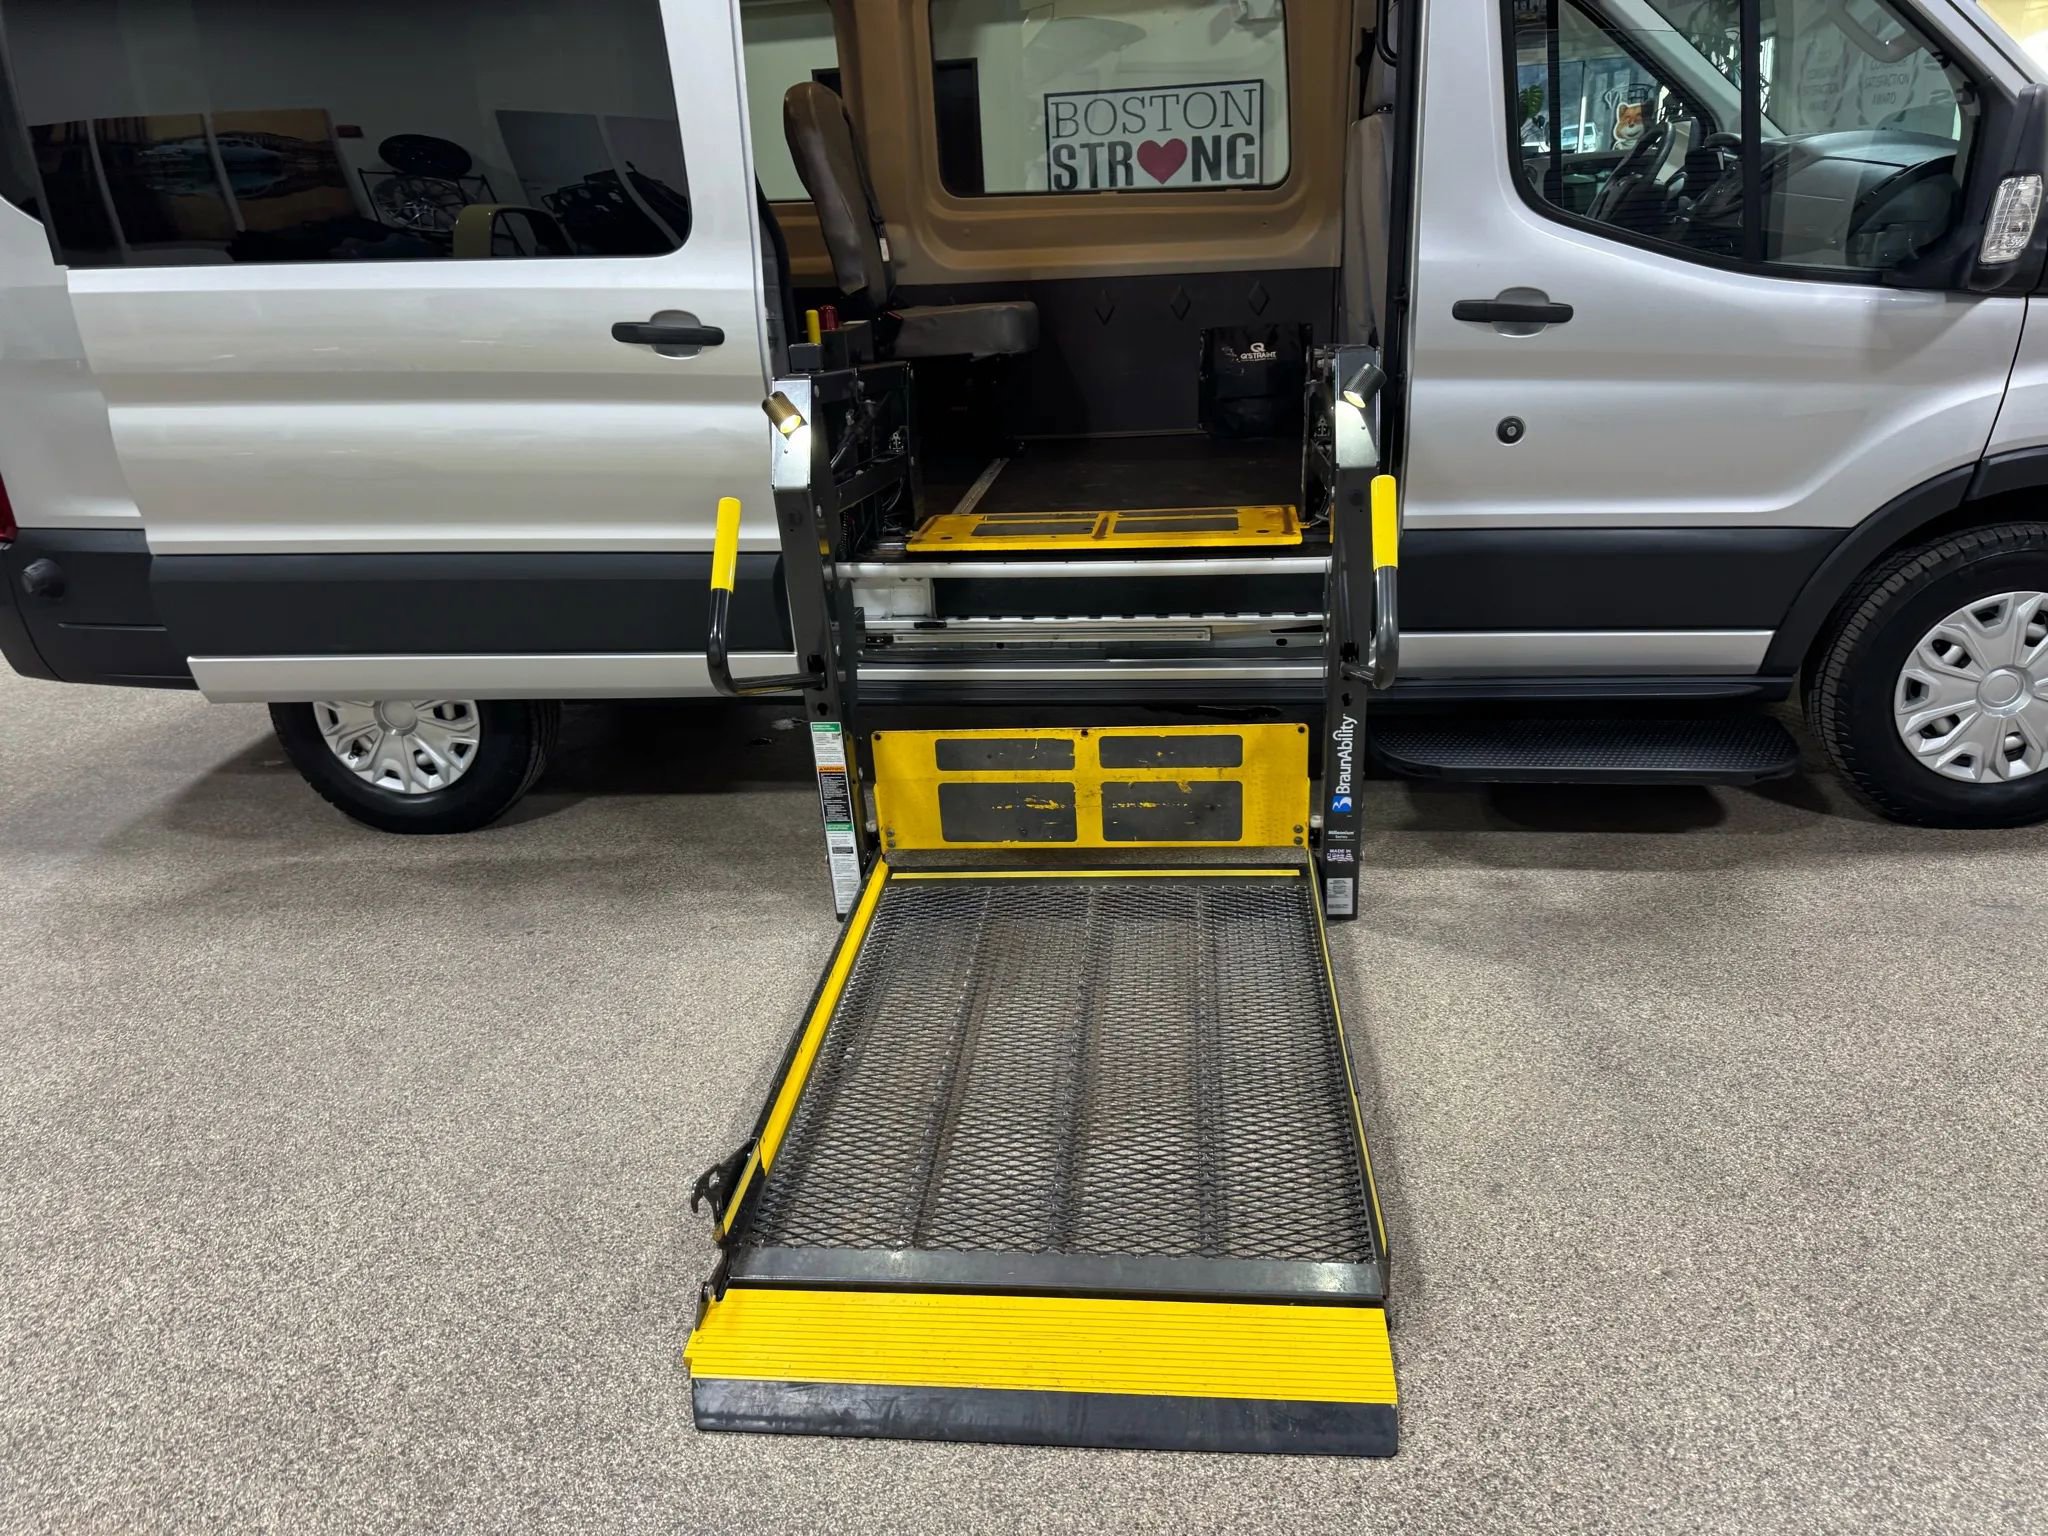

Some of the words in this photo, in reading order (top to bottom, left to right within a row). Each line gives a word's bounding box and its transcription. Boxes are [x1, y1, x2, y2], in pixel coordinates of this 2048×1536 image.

[1050, 88, 1257, 139] BOSTON
[1052, 132, 1256, 191] STRNG
[1332, 713, 1358, 794] BraunAbility
